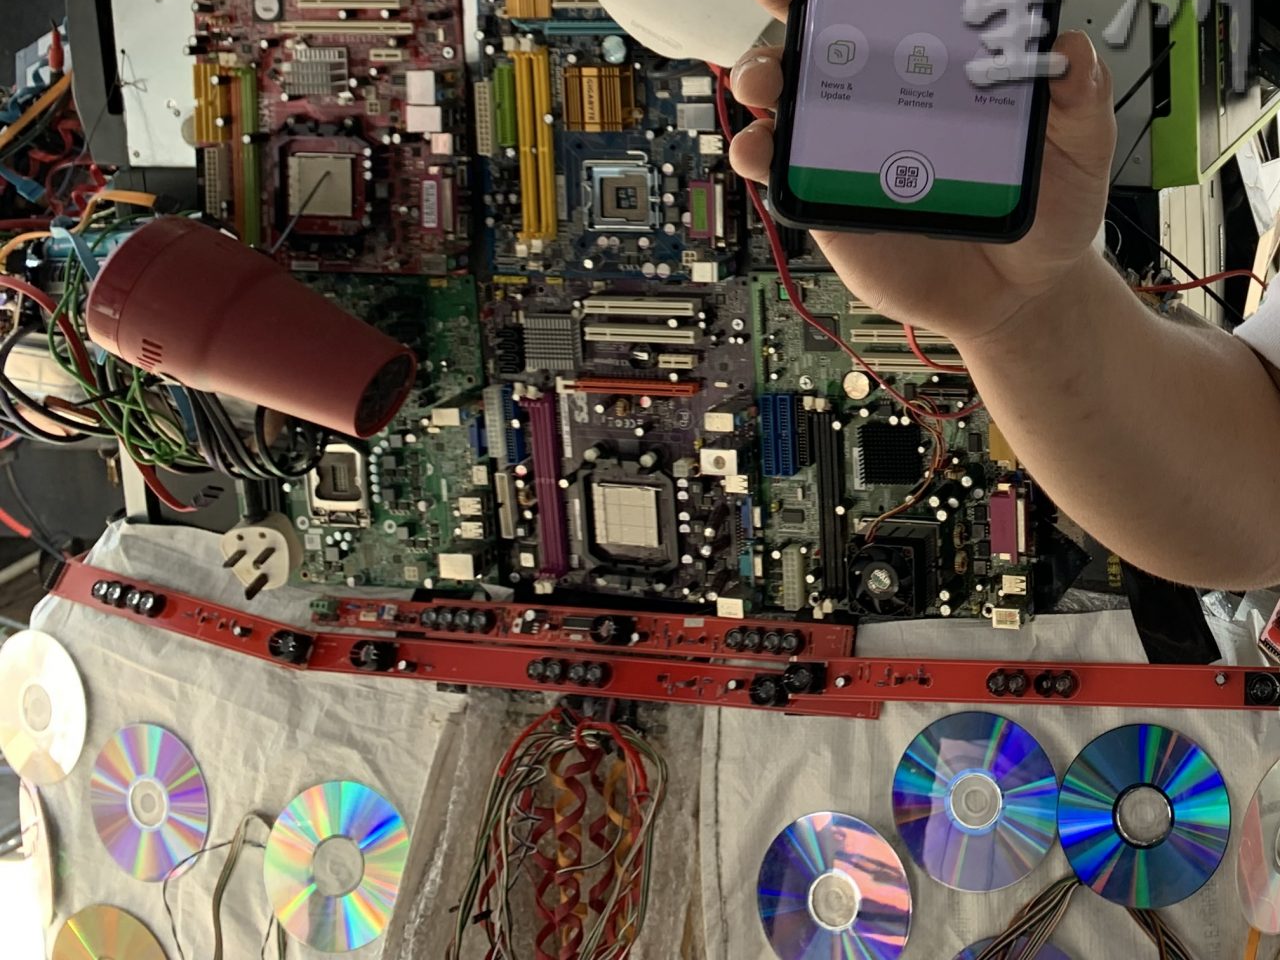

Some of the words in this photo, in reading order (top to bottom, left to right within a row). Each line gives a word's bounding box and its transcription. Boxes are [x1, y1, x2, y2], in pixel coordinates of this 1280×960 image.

[820, 80, 845, 91] News
[846, 83, 853, 91] &
[820, 90, 852, 102] Update
[974, 95, 988, 105] My
[988, 96, 1016, 107] Profile
[897, 98, 934, 110] Partners
